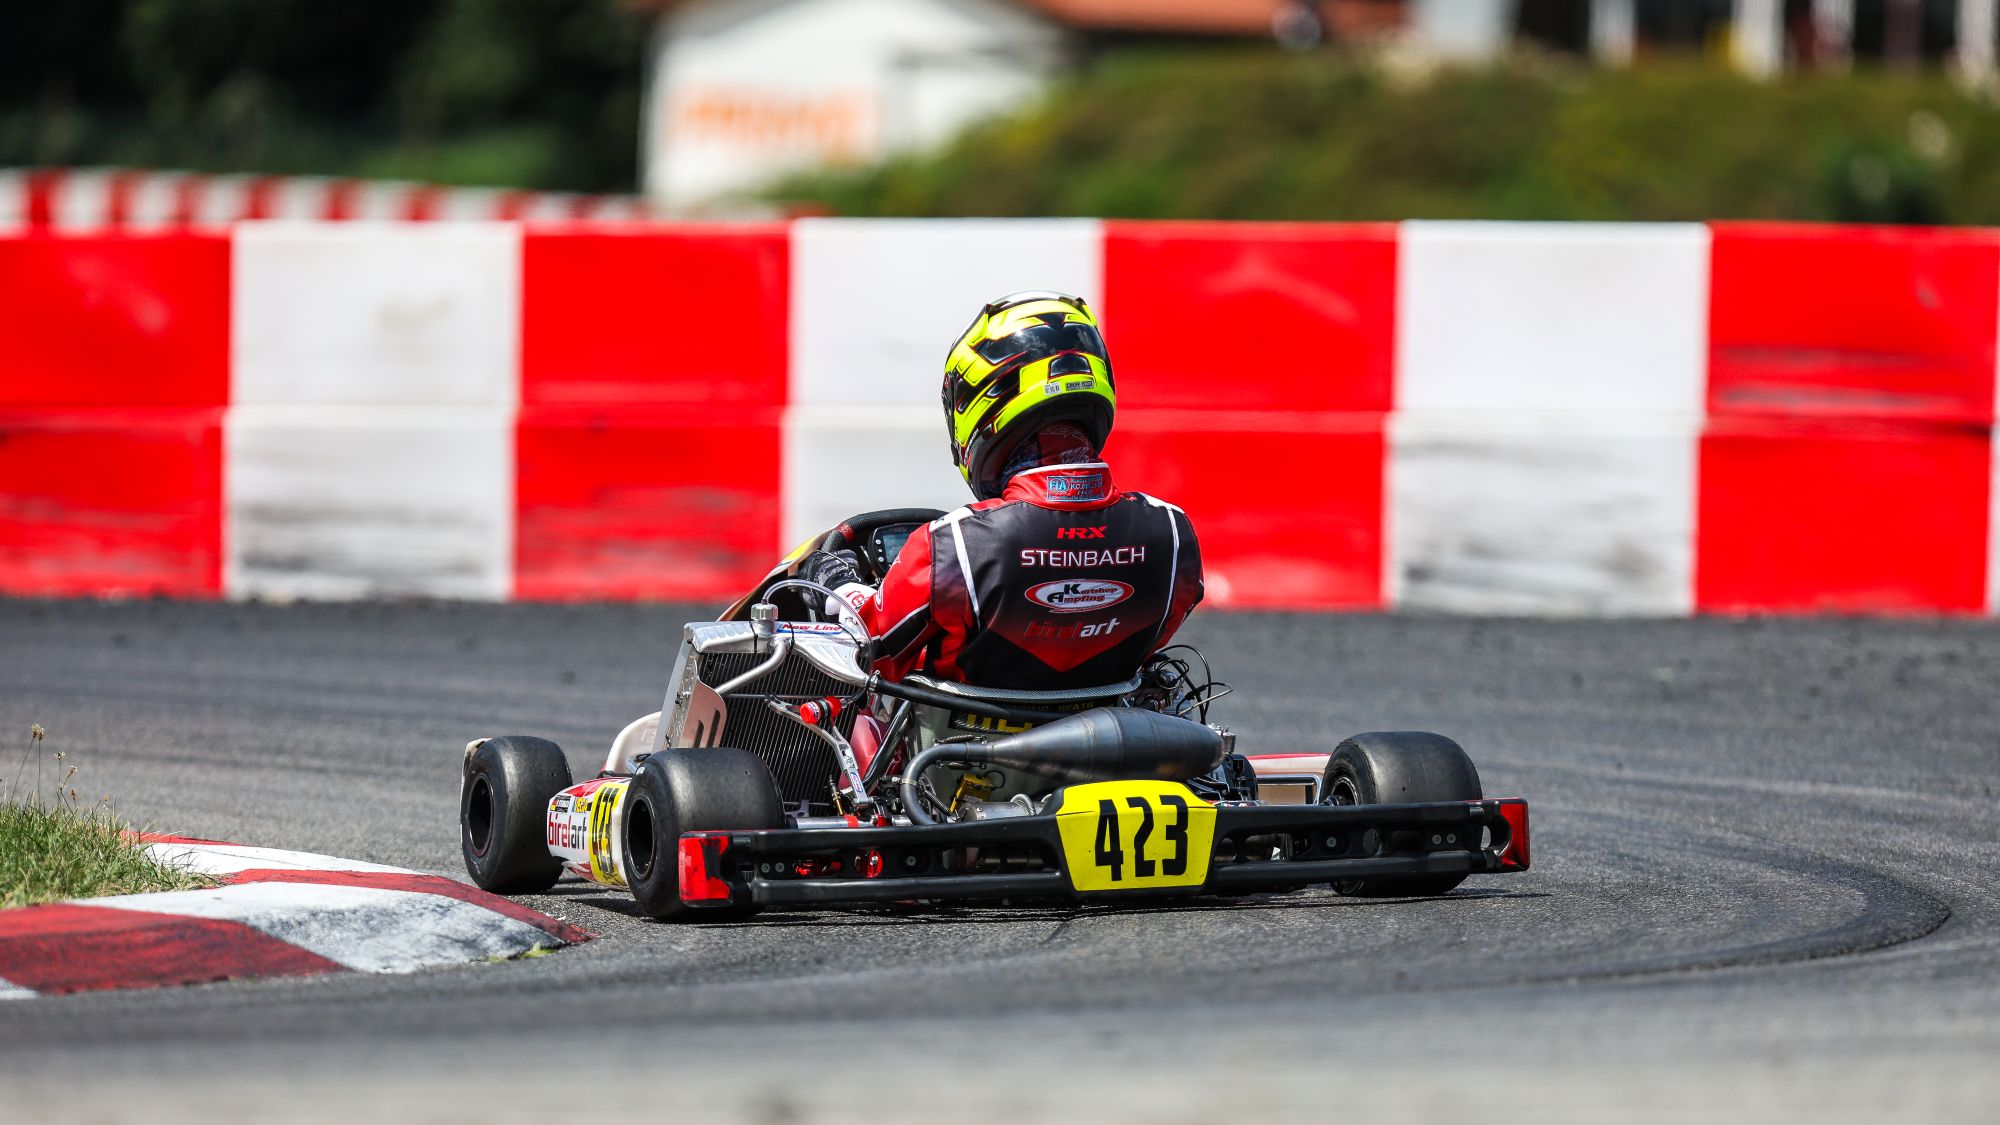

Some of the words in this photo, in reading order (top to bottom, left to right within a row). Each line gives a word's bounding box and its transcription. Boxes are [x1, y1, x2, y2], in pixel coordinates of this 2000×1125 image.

[1049, 480, 1067, 492] FIA
[1057, 526, 1106, 539] HRX
[1021, 546, 1145, 567] STEINBACH
[1063, 583, 1117, 595] Kartshop
[548, 812, 587, 850] birelart
[1094, 795, 1189, 881] 423
